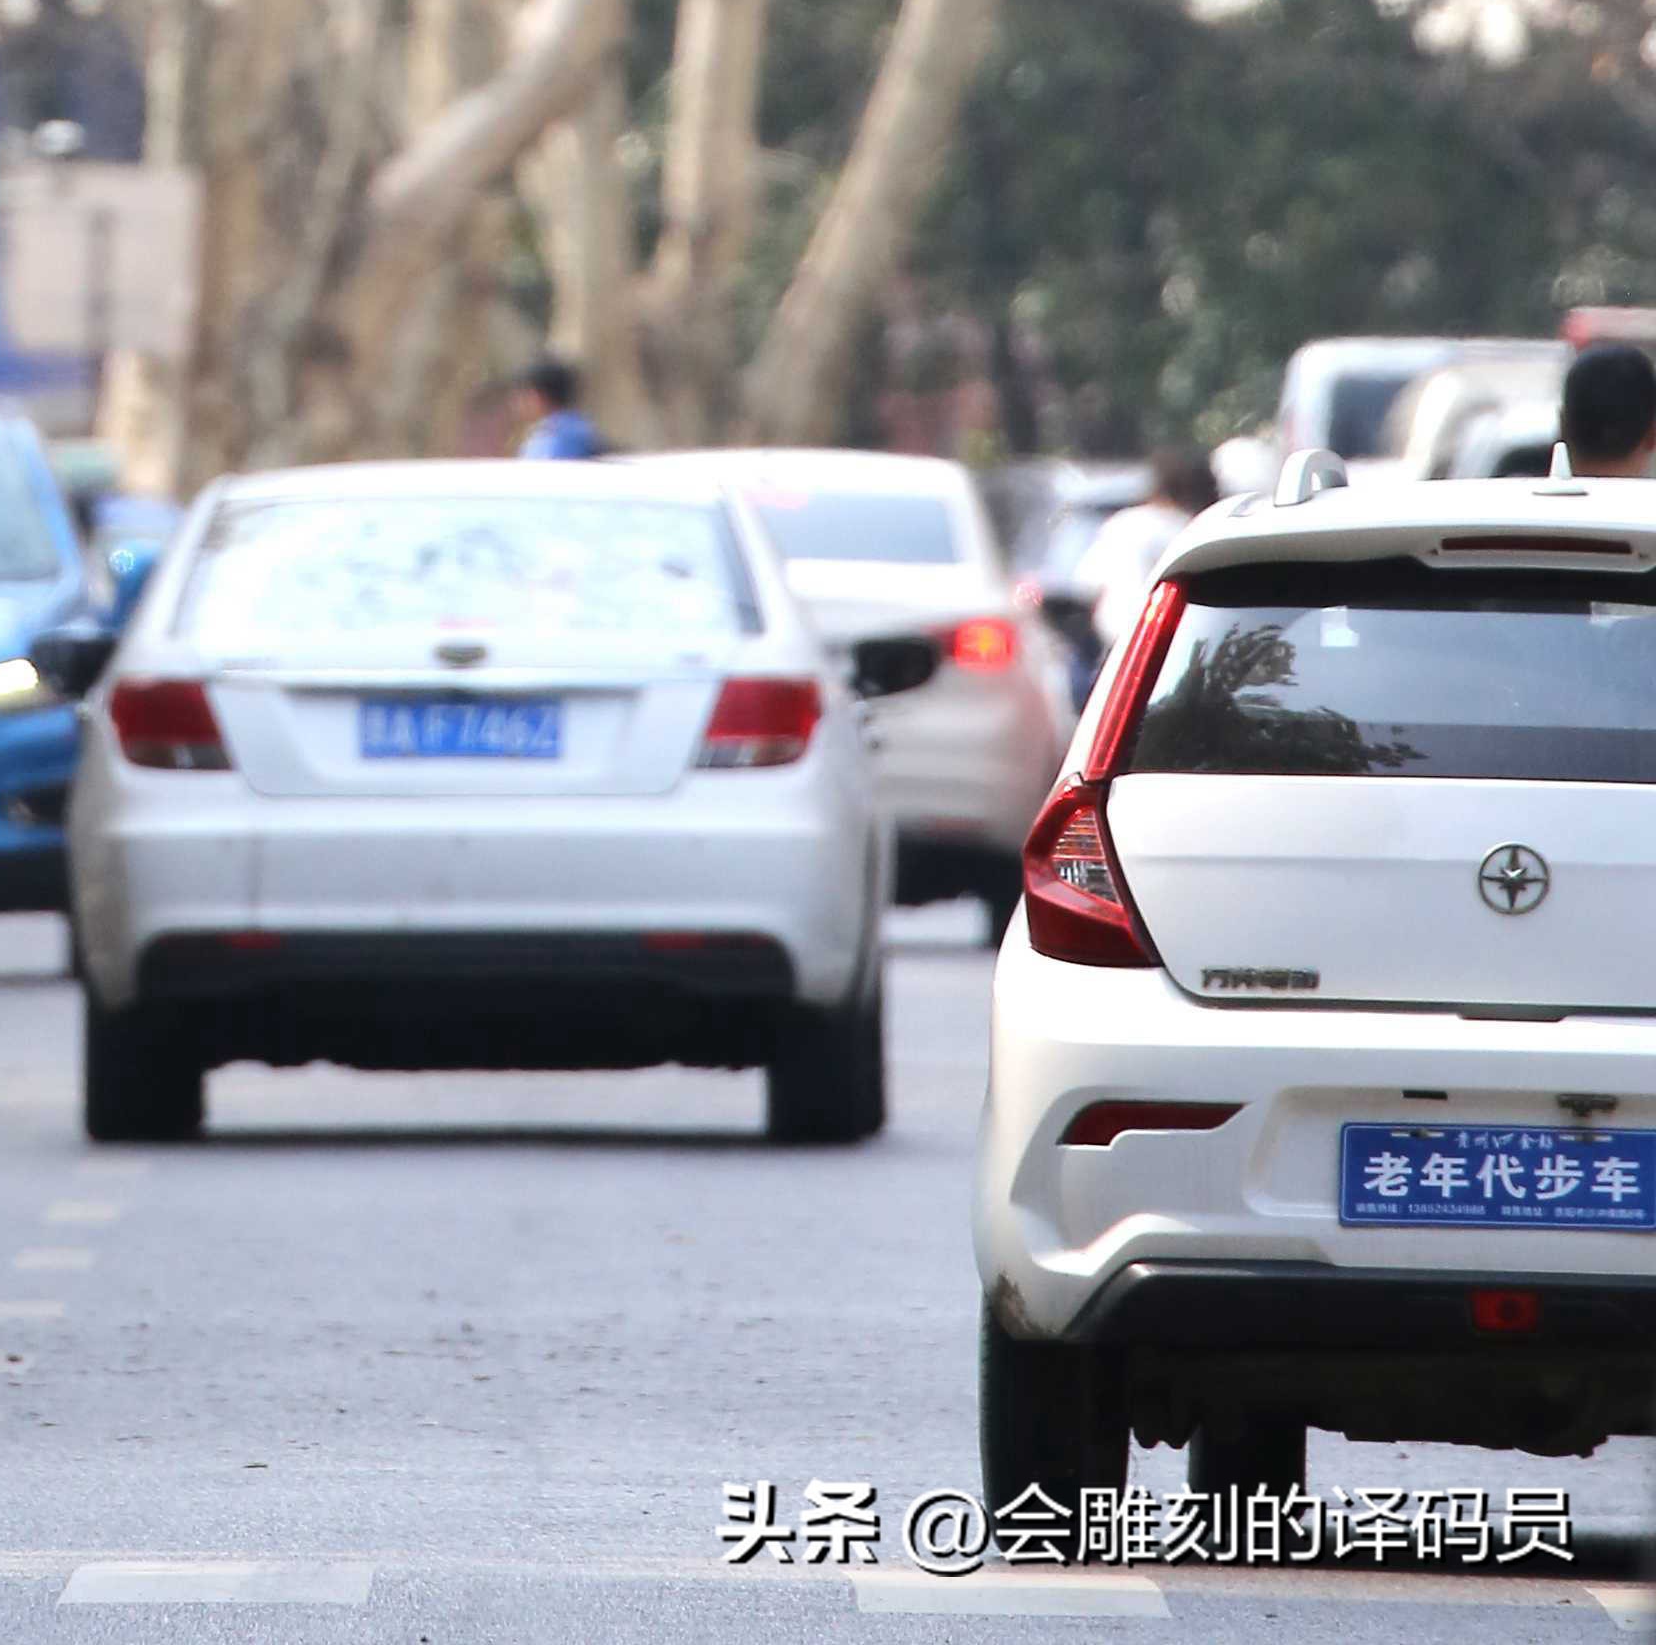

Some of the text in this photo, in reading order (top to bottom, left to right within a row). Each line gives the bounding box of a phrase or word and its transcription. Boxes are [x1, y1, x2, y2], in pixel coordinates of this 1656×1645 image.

[1362, 1151, 1641, 1203] 老年代步车
